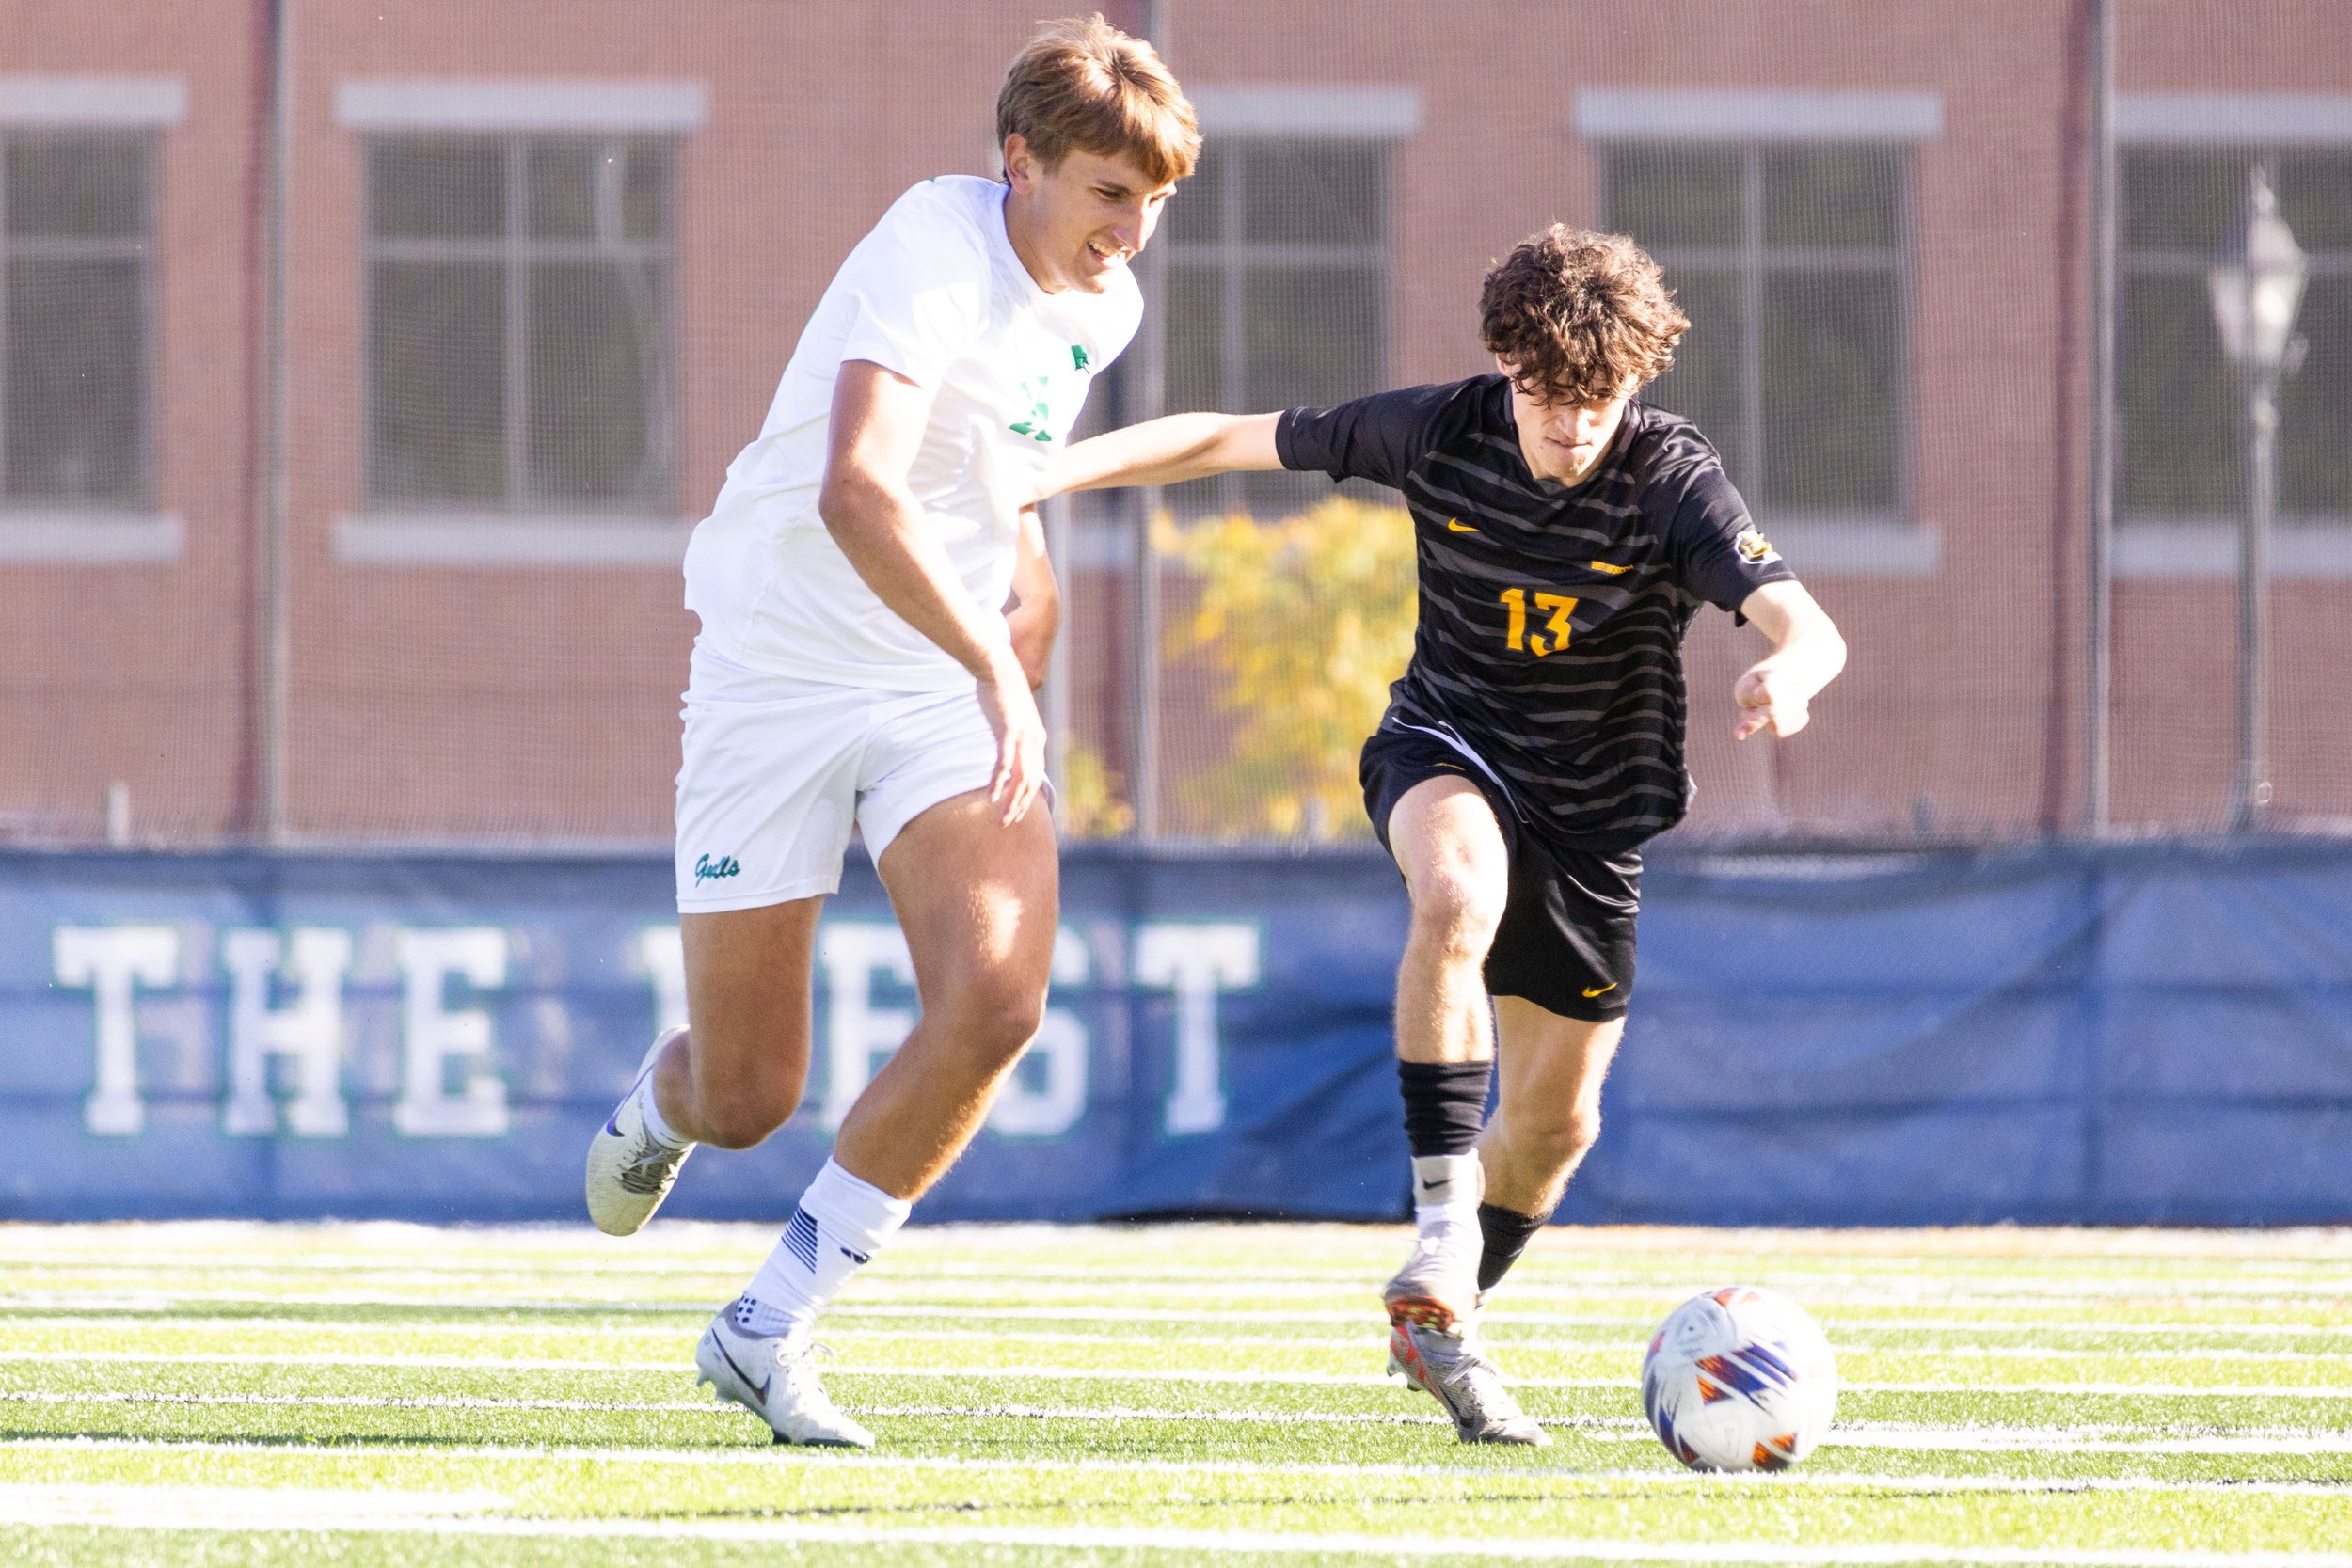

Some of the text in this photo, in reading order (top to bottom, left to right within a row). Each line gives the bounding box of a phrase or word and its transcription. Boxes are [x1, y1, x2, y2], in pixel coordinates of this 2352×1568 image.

[1501, 588, 1579, 657] 13
[694, 852, 741, 888] Gulls
[54, 925, 509, 1136] THE
